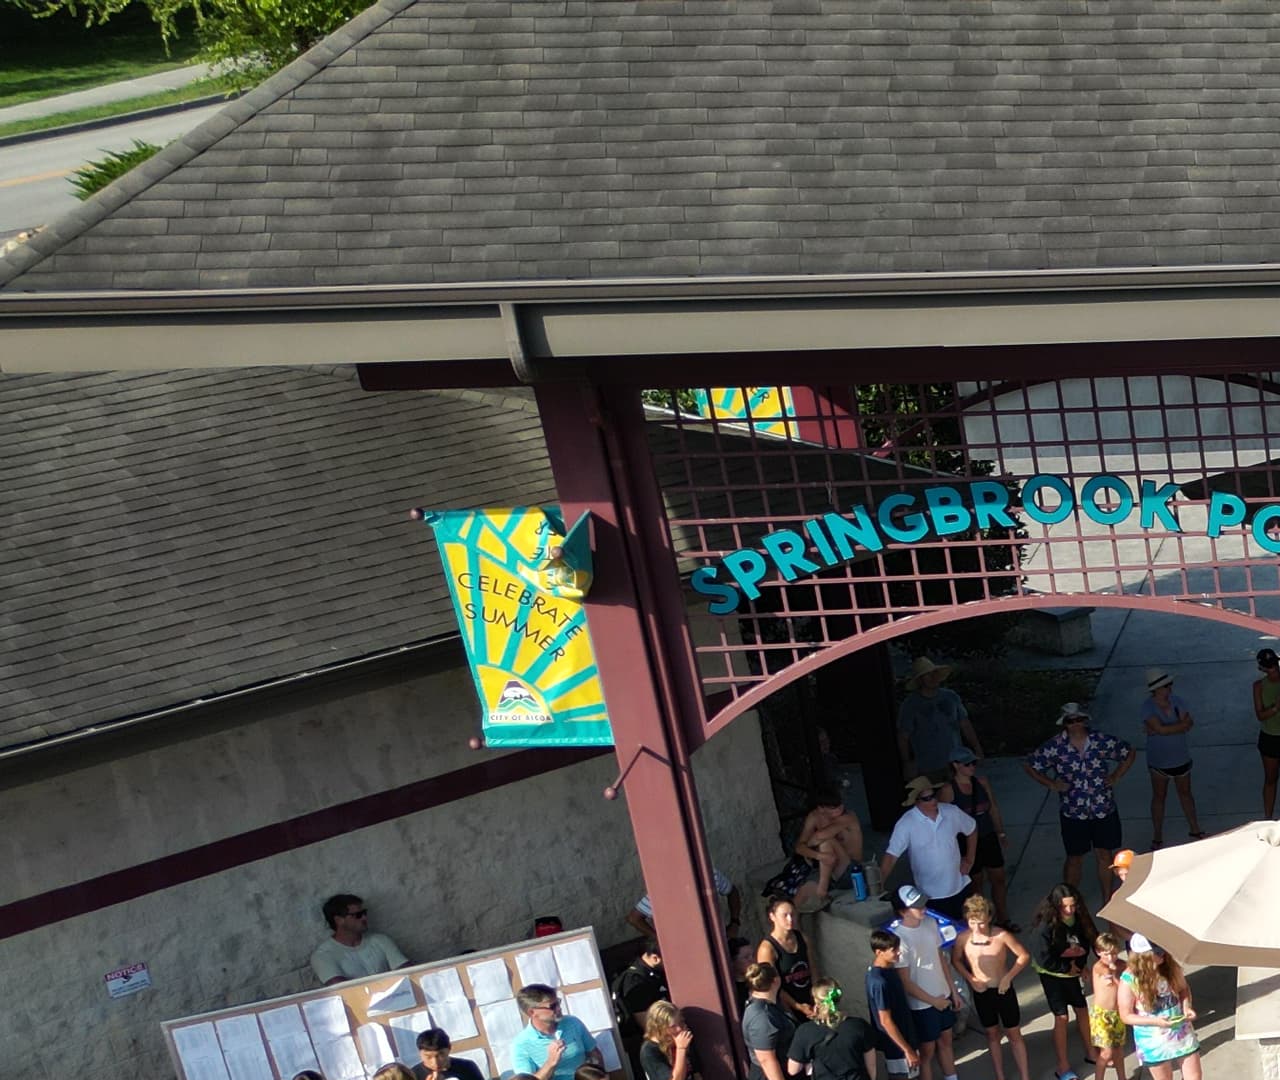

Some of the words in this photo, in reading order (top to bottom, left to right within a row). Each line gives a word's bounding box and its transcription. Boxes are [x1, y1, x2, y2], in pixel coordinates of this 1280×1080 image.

[690, 474, 1180, 617] SPRINGBROOK
[457, 571, 584, 642] CELEBRATE
[464, 601, 566, 663] SUMMER
[106, 964, 143, 980] NOTICE
